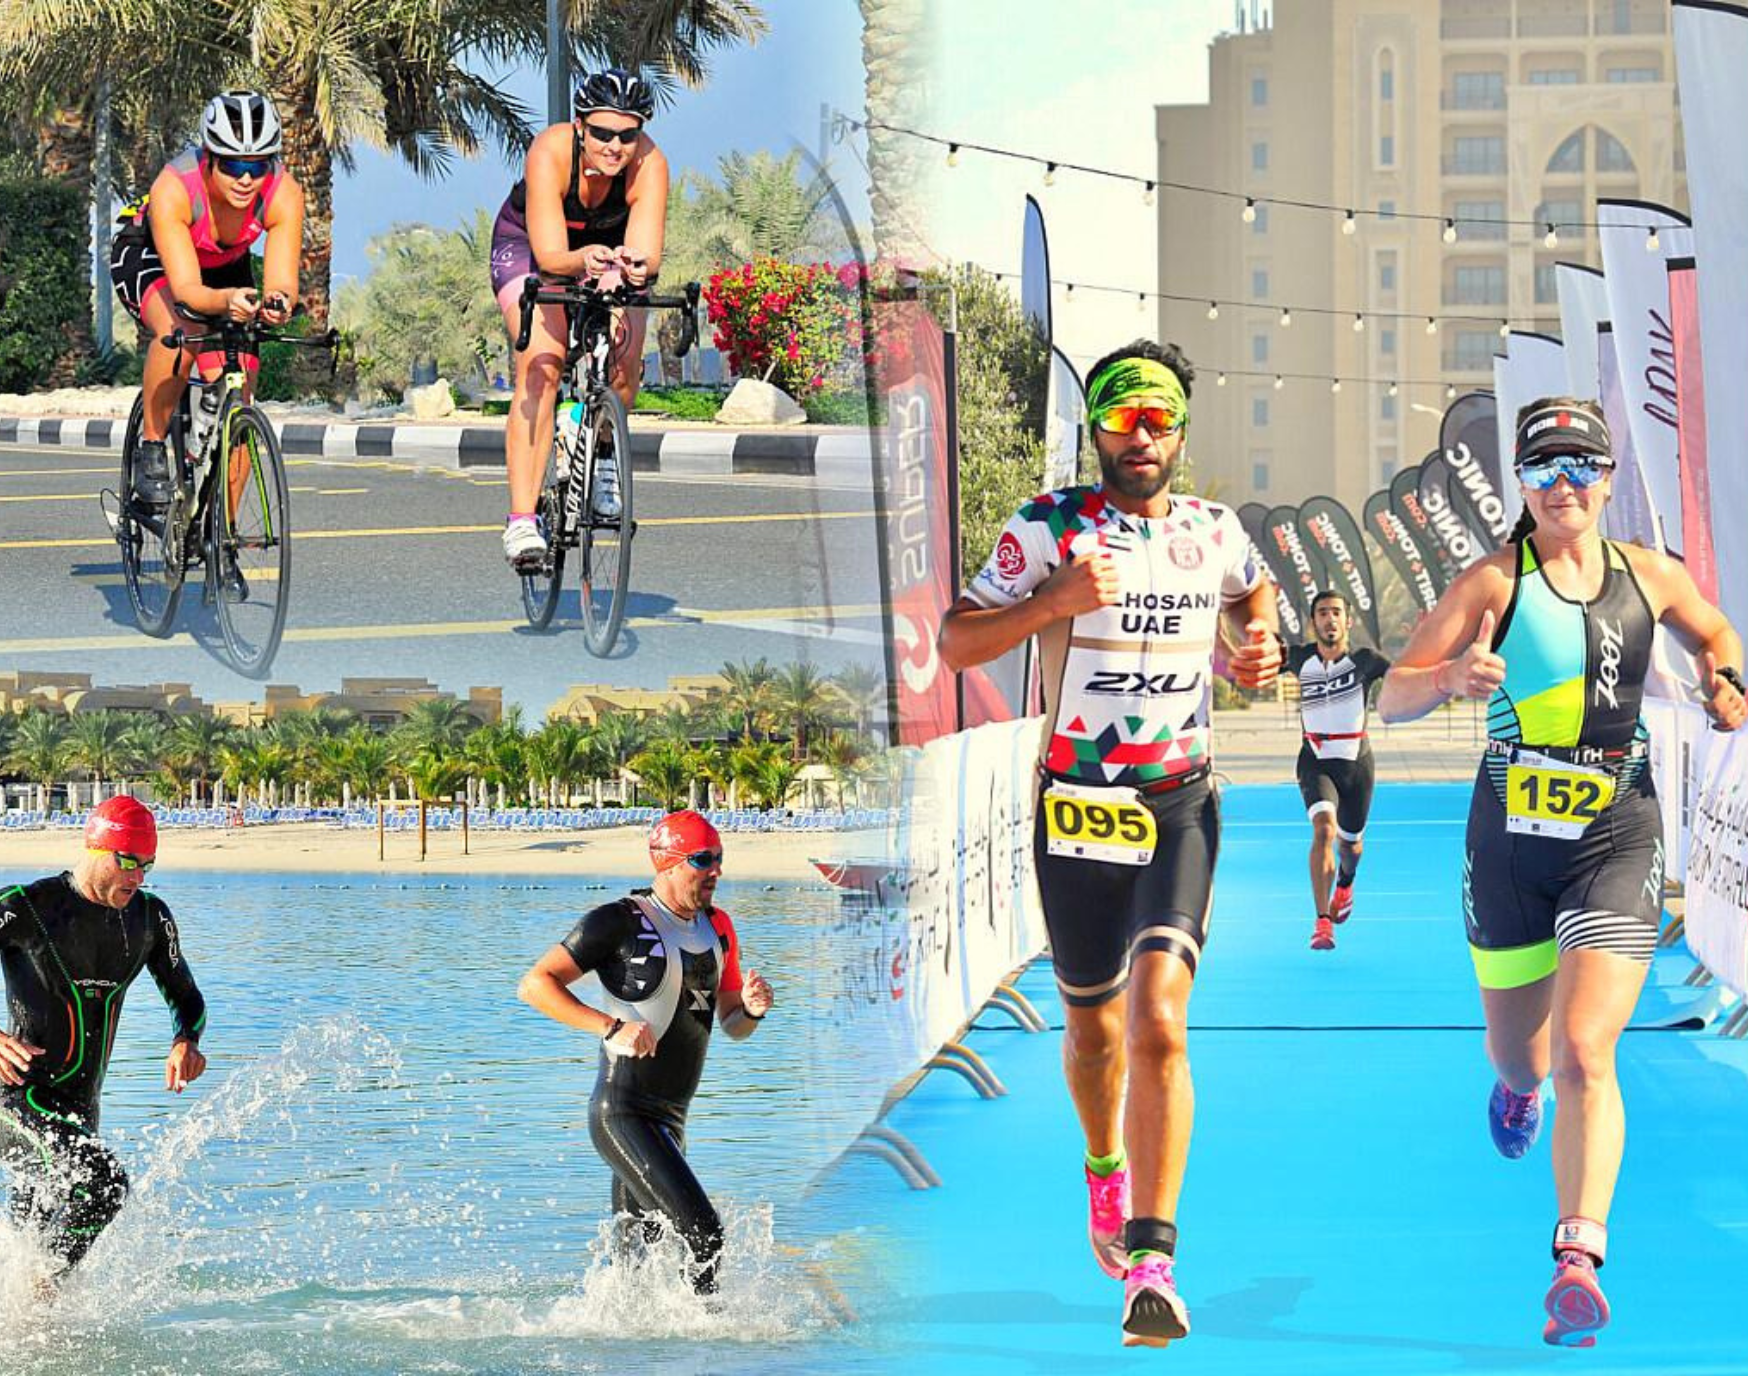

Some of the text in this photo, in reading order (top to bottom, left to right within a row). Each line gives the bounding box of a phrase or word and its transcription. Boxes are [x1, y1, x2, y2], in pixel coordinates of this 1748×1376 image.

[1121, 614, 1182, 635] UAE
[1519, 774, 1602, 819] 152
[1053, 800, 1148, 843] 095
